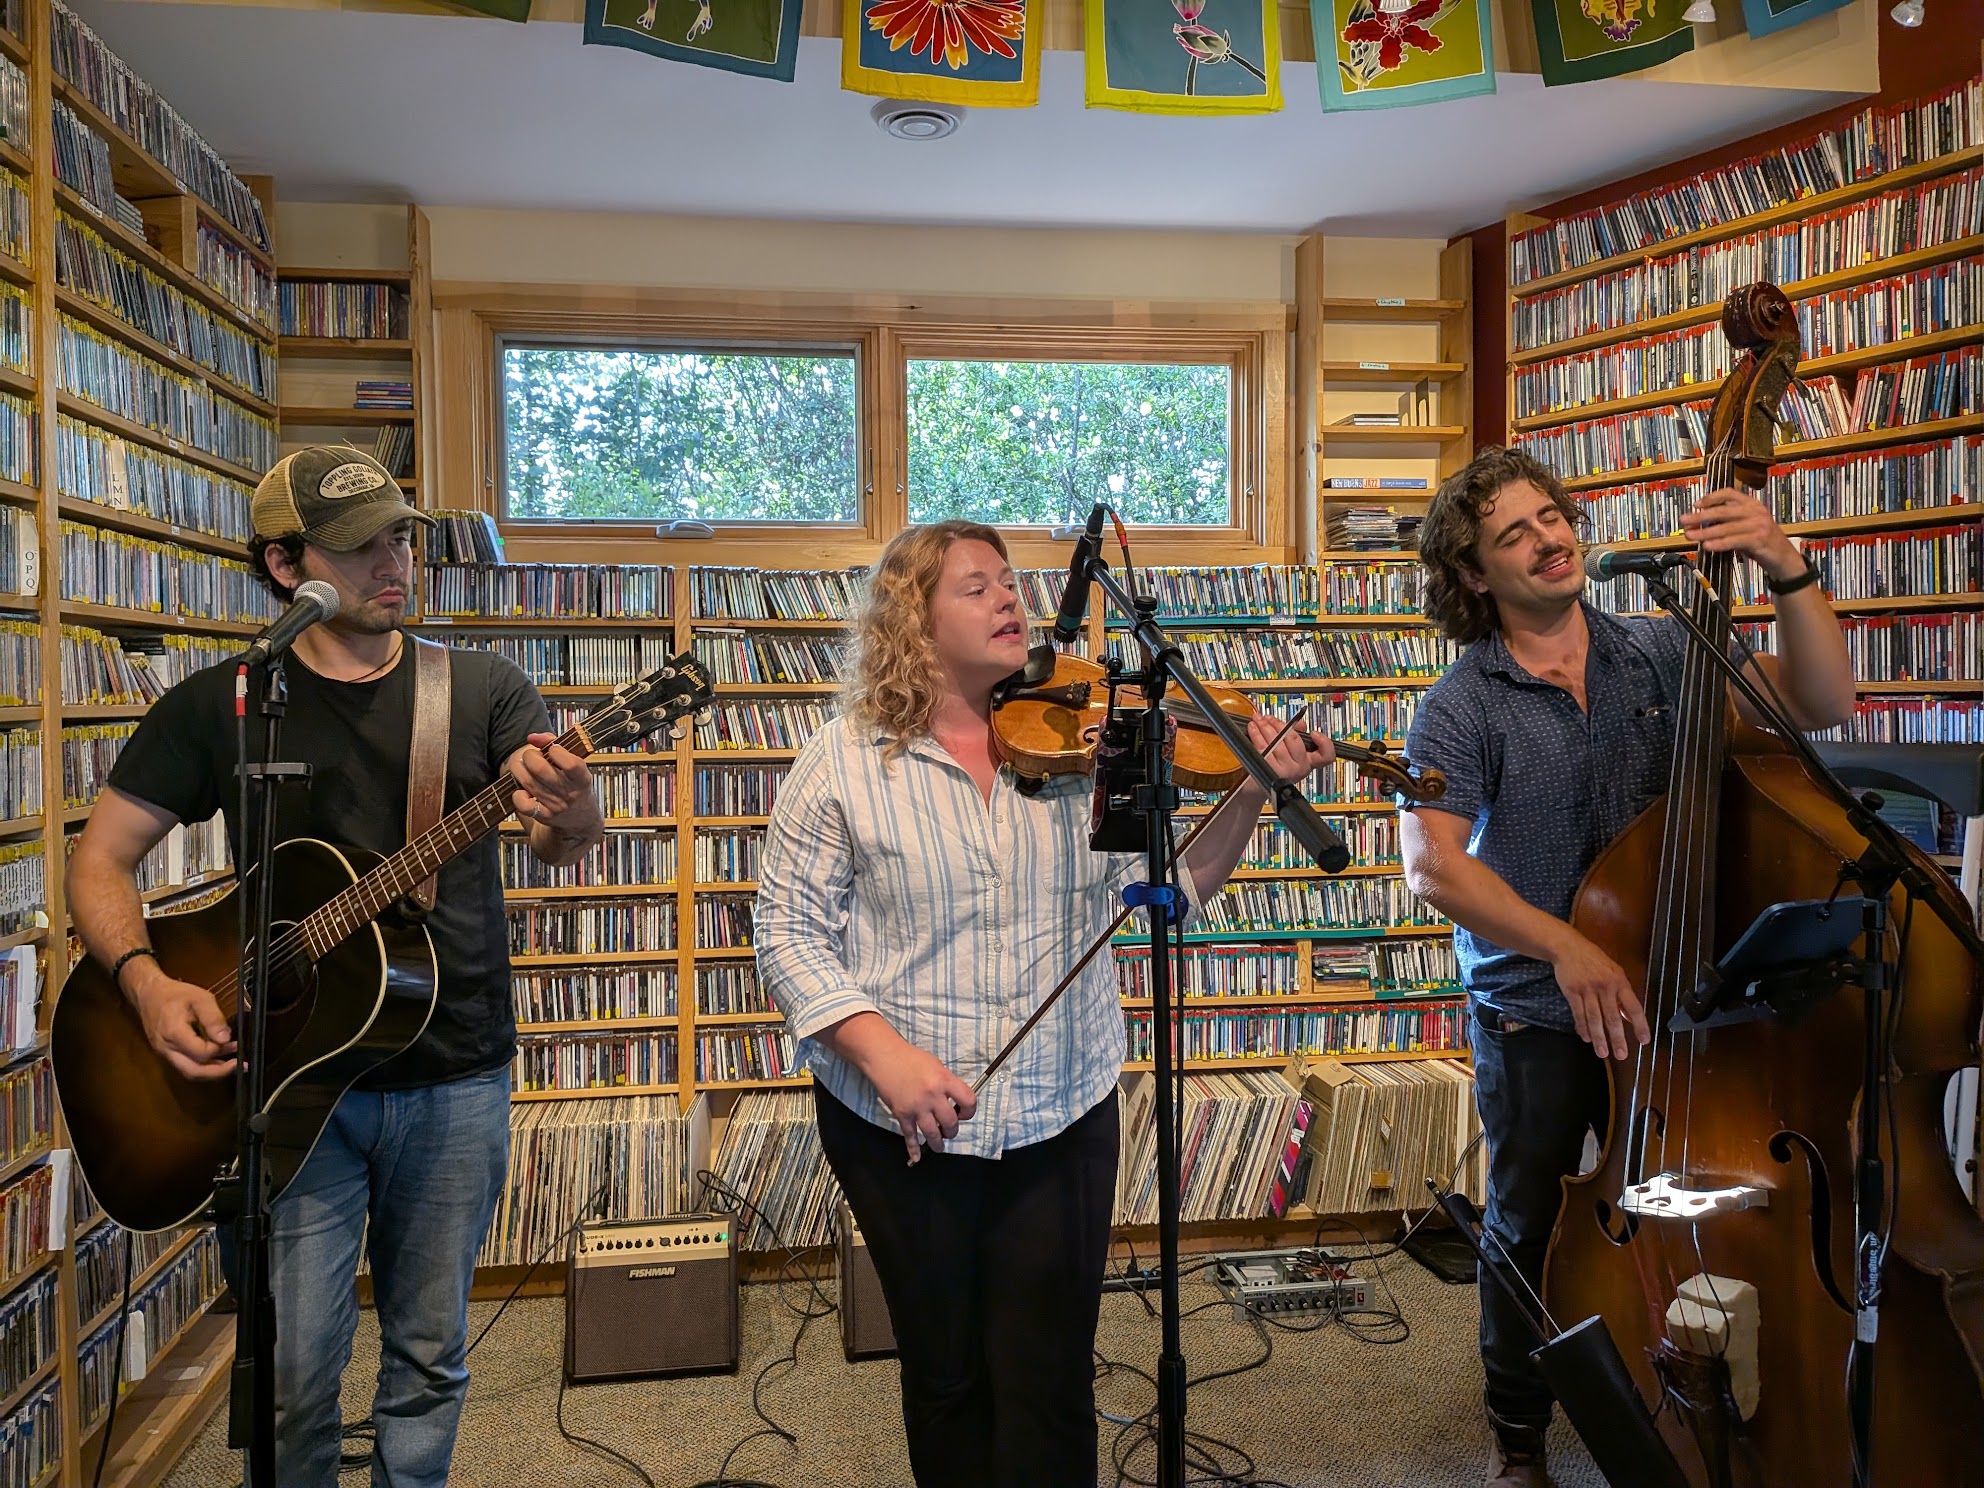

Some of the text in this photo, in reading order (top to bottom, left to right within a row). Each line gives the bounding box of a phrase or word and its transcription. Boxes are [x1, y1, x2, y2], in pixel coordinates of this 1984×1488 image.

[321, 466, 353, 490] TOPPLING
[336, 477, 369, 493] BREWING
[1364, 479, 1378, 488] JAZZ
[114, 485, 123, 493] M
[114, 497, 122, 505] N
[25, 551, 36, 589] O P Q
[678, 663, 706, 692] Gibson
[628, 1266, 676, 1279] FISHMAN
